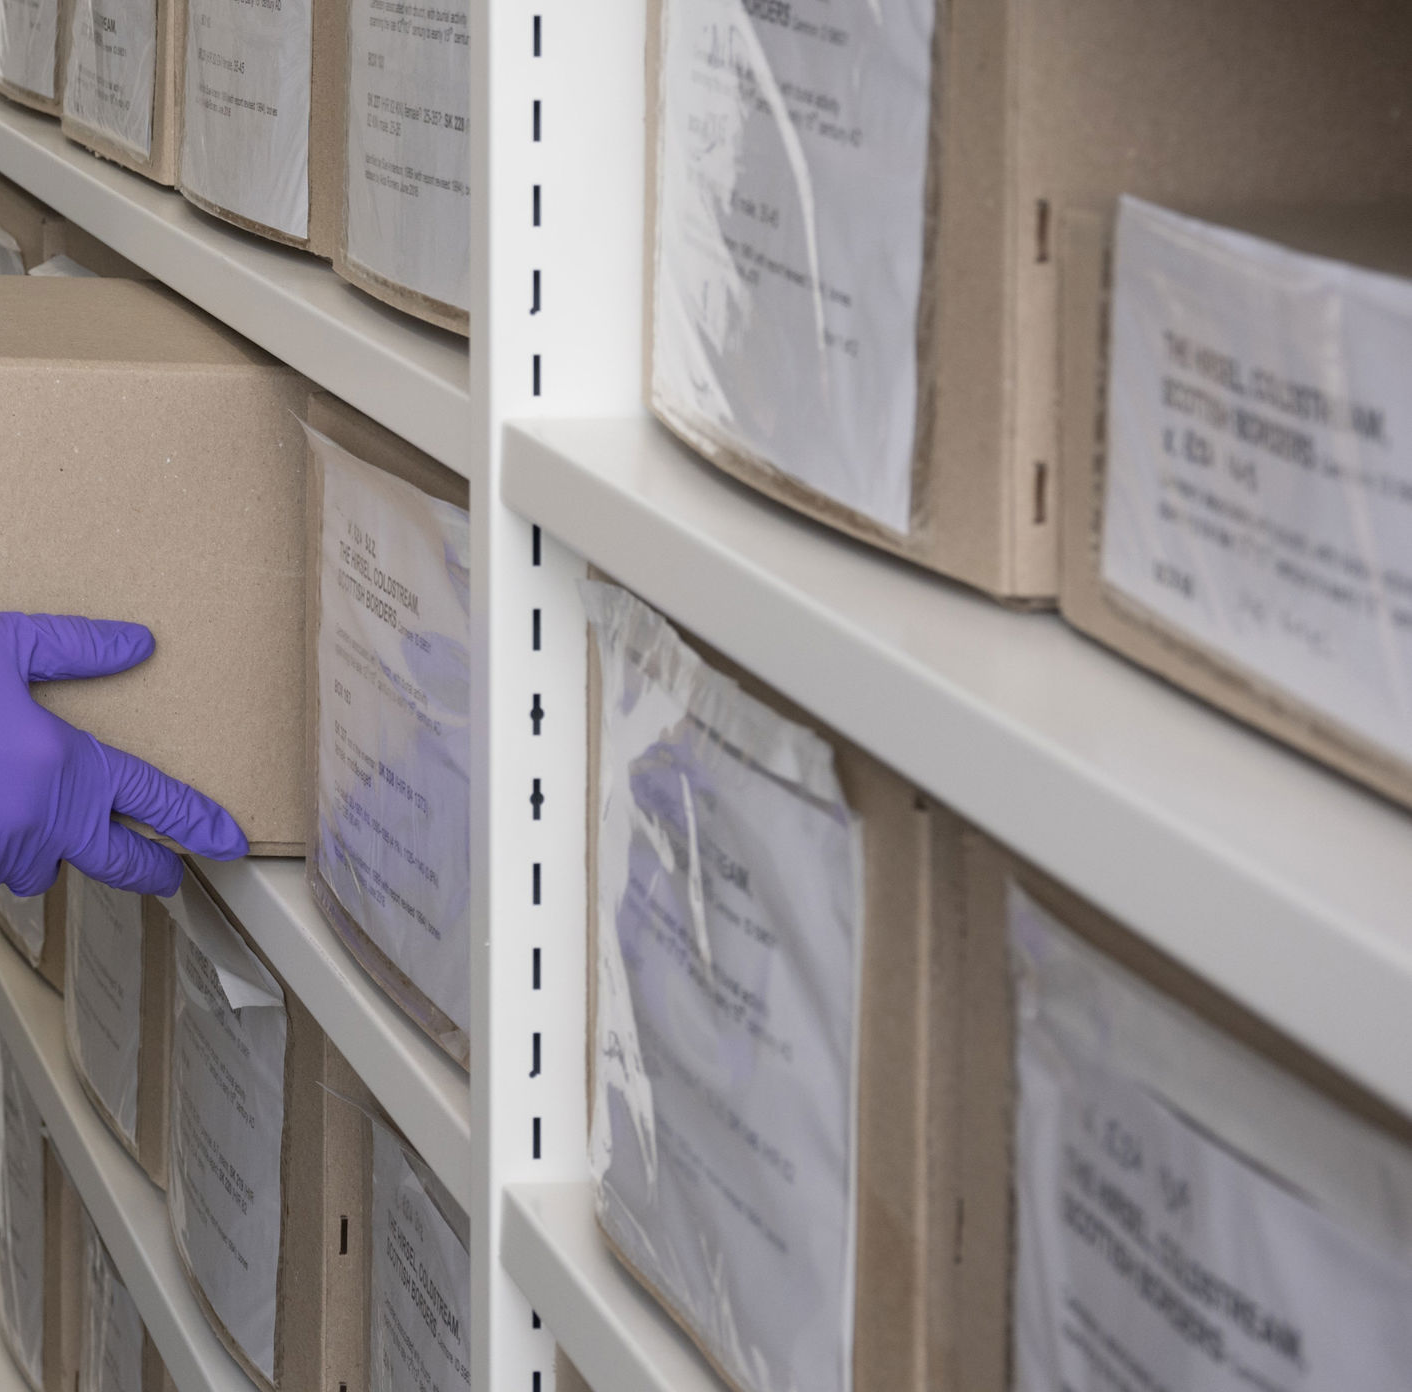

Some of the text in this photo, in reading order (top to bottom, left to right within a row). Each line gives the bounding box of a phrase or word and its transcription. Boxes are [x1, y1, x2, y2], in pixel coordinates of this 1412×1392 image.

[337, 566, 365, 608] SCOTTISH
[365, 588, 398, 630] BORDERS
[339, 538, 421, 622] THE HIRSEL, COLDSTREAM,
[386, 1236, 412, 1294] SCOTTISH
[411, 1278, 437, 1339] BORDERS
[388, 1207, 398, 1242] THE
[419, 1261, 461, 1346] COLDSTREAM,
